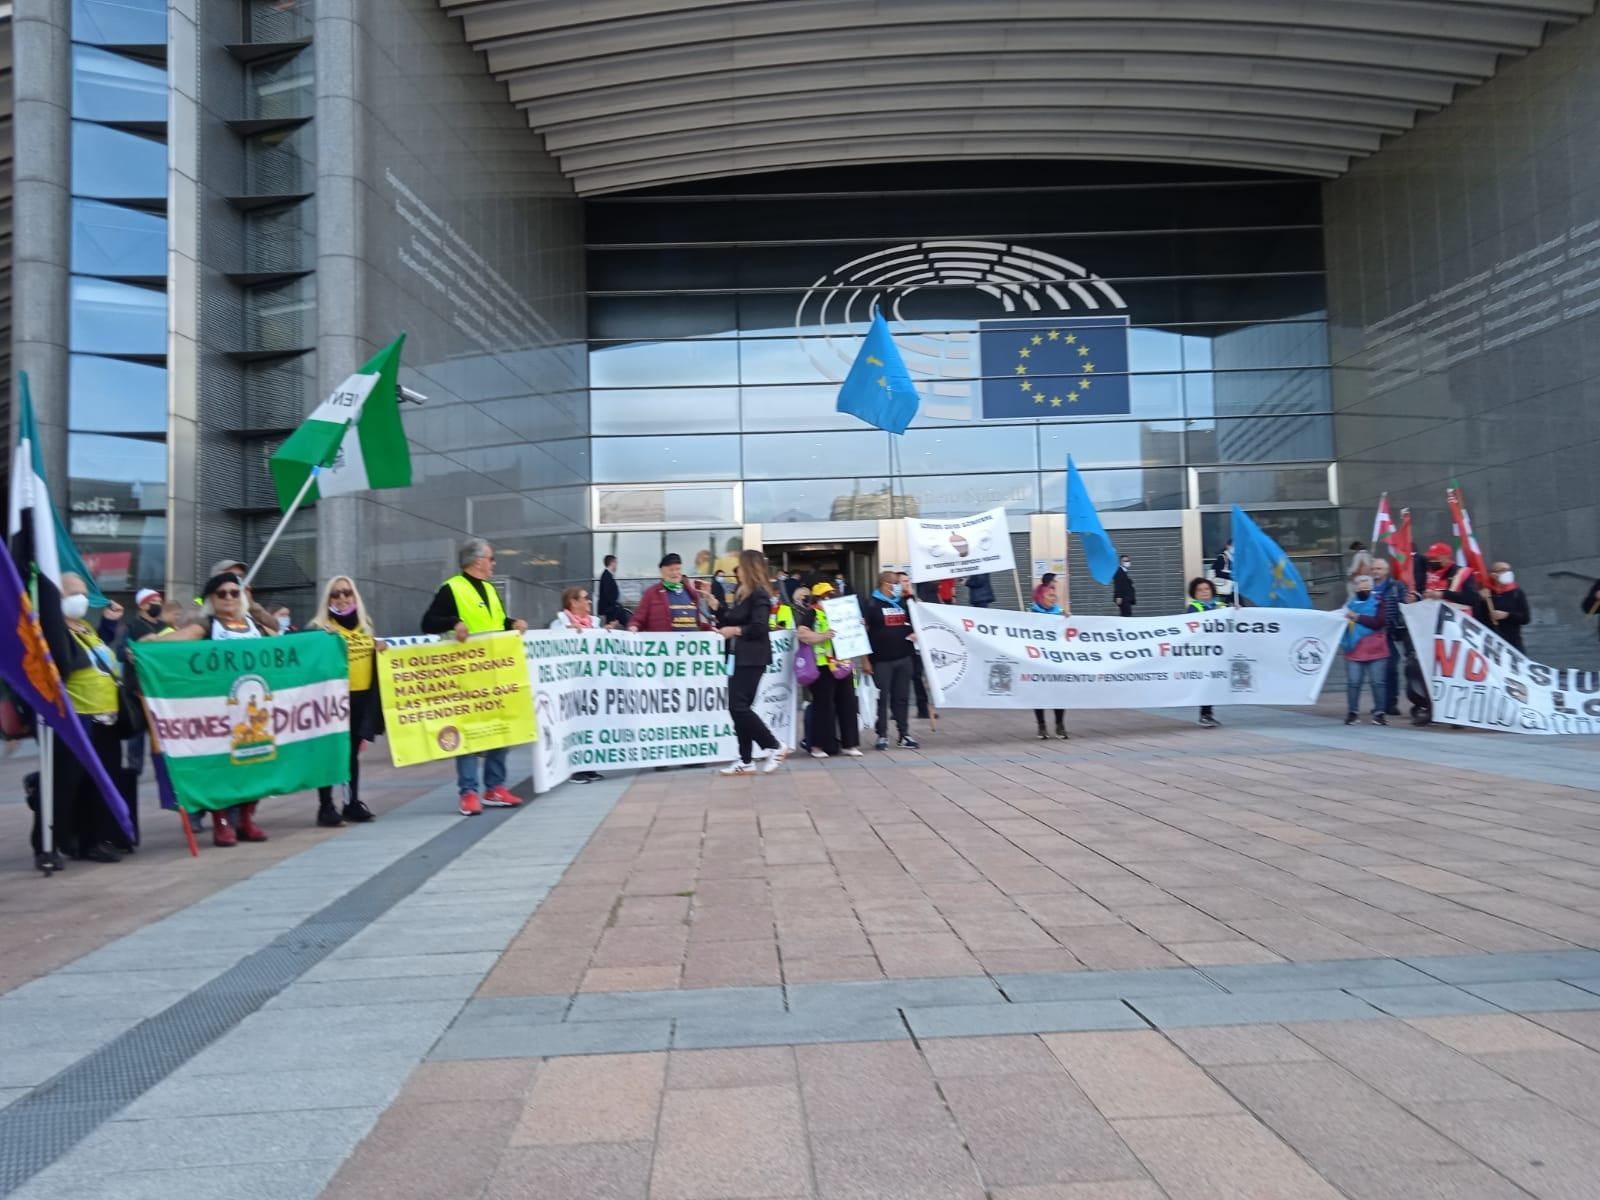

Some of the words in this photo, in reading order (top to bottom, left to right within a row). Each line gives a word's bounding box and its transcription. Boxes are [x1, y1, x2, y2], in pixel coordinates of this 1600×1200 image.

[961, 618, 999, 637] Por
[1005, 626, 1057, 642] unas
[1065, 626, 1181, 643] Pensiones
[1186, 618, 1281, 634] Públicas
[391, 658, 405, 670] SI
[408, 648, 486, 667] QUEREMOS
[676, 640, 711, 656] POR
[1025, 645, 1103, 664] Dignas
[1109, 649, 1153, 661] con
[1158, 642, 1224, 657] Futuro
[1433, 638, 1489, 683] NO
[188, 647, 300, 675] CÓRDOBA
[393, 664, 467, 683] PENSIONES
[470, 656, 515, 673] DIGNAS
[664, 661, 687, 677] DE
[1097, 672, 1169, 683] PENSIONISTES
[396, 698, 421, 711] LAS
[425, 688, 489, 706] TENEMOS
[492, 683, 520, 696] QUE
[686, 686, 729, 713] DIGN
[272, 695, 350, 734] DIGNAS
[398, 704, 471, 725] DEFENDER
[473, 700, 506, 714] HOY.
[639, 725, 710, 742] GOBIERNE
[714, 724, 737, 737] LA
[640, 742, 718, 761] DEFIENDEN
